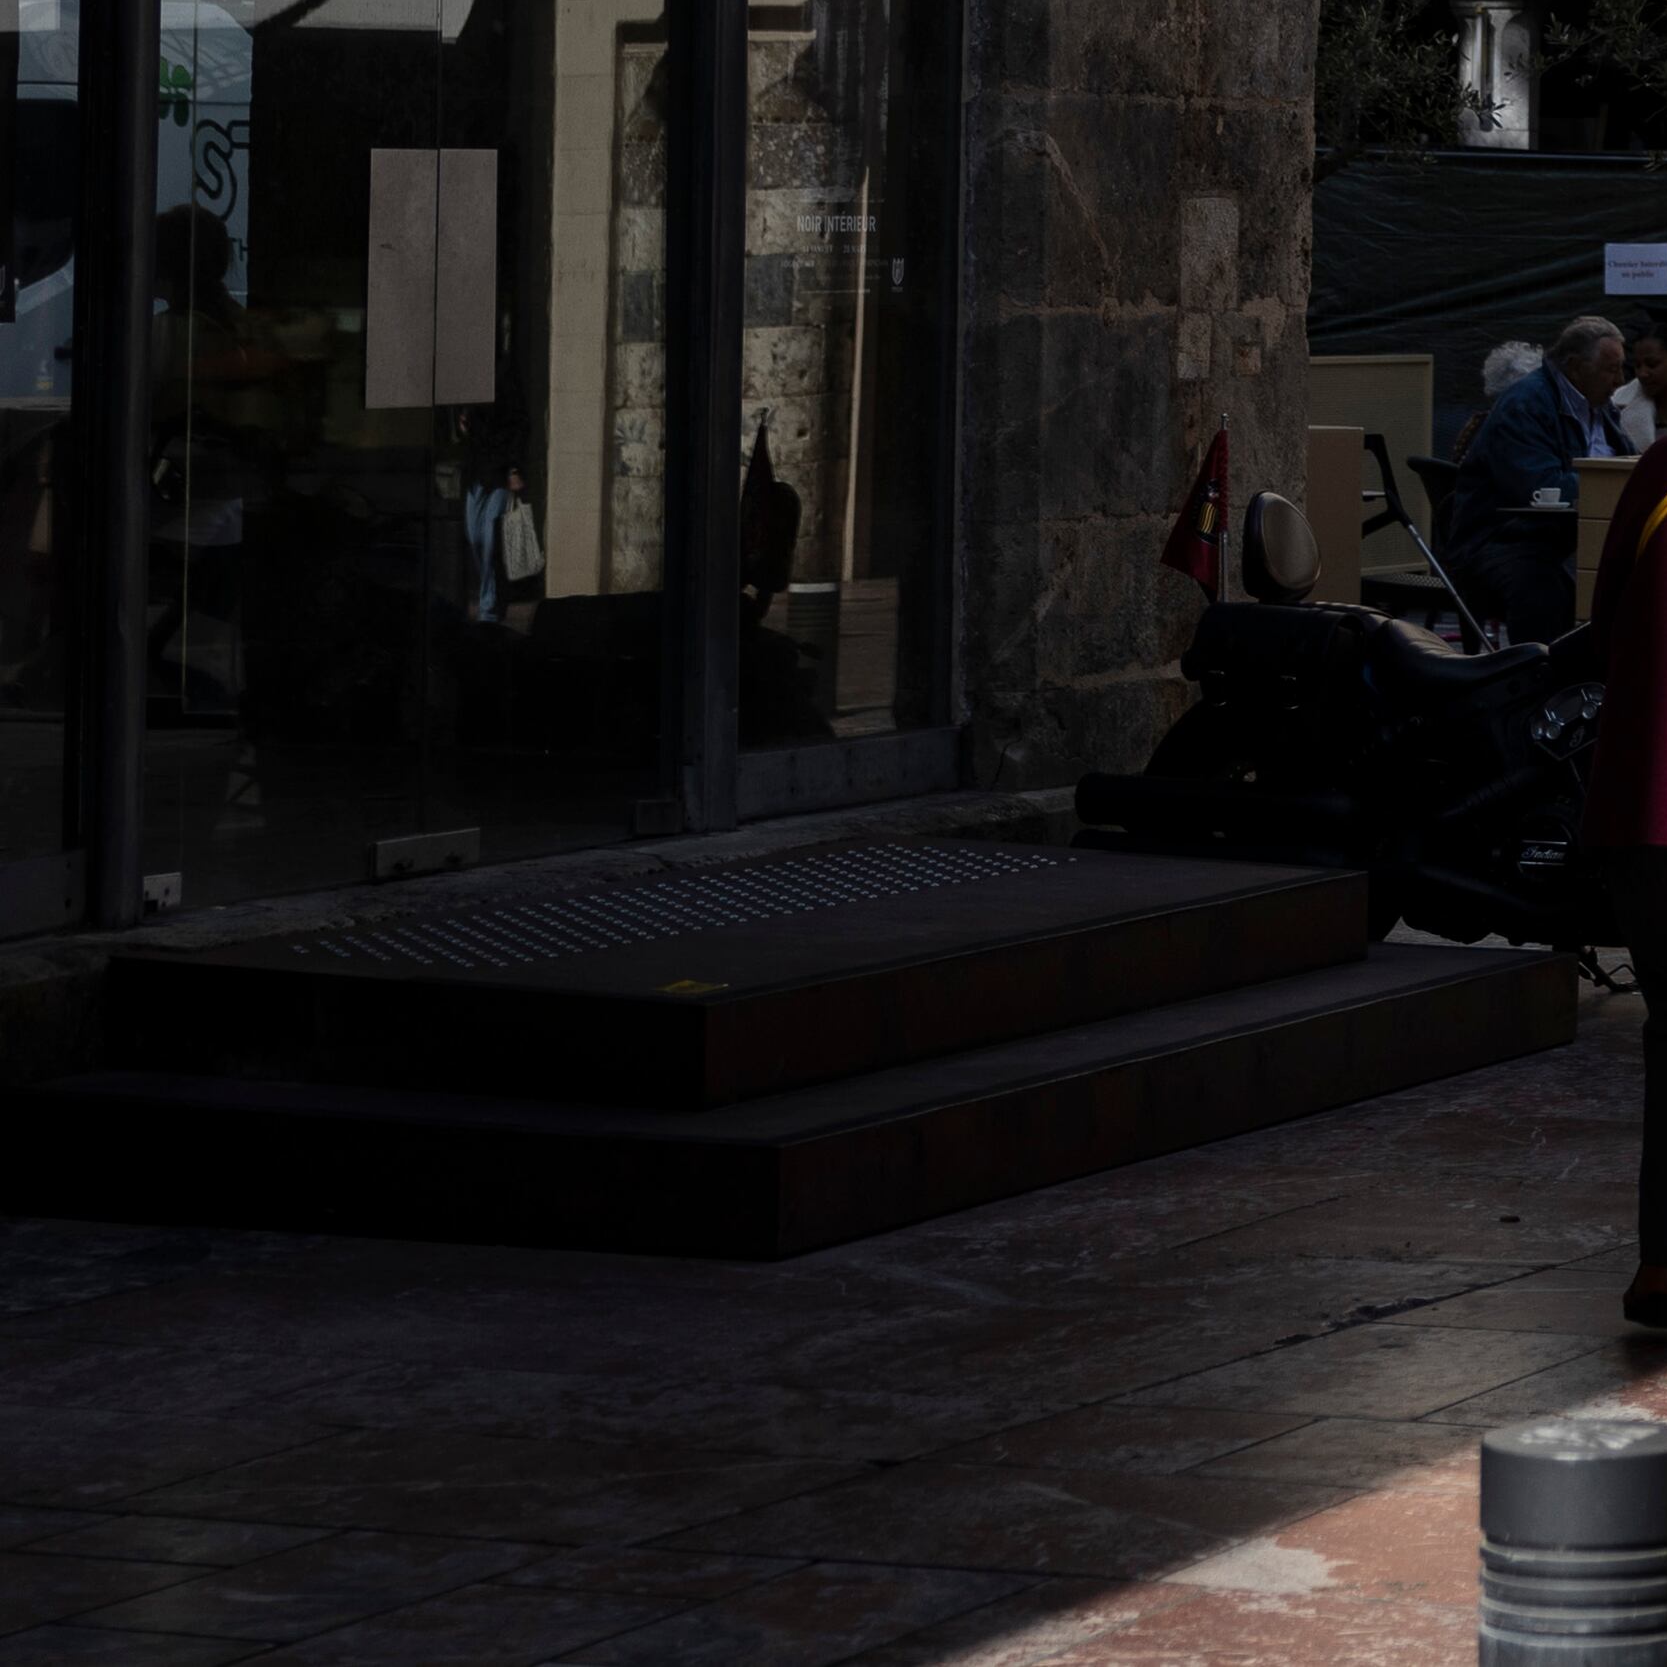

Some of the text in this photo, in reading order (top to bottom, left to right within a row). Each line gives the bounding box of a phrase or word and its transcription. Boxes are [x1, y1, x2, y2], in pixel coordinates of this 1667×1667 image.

[797, 210, 878, 233] NOIR INTÉRIEUR
[1520, 845, 1567, 862] Indian
